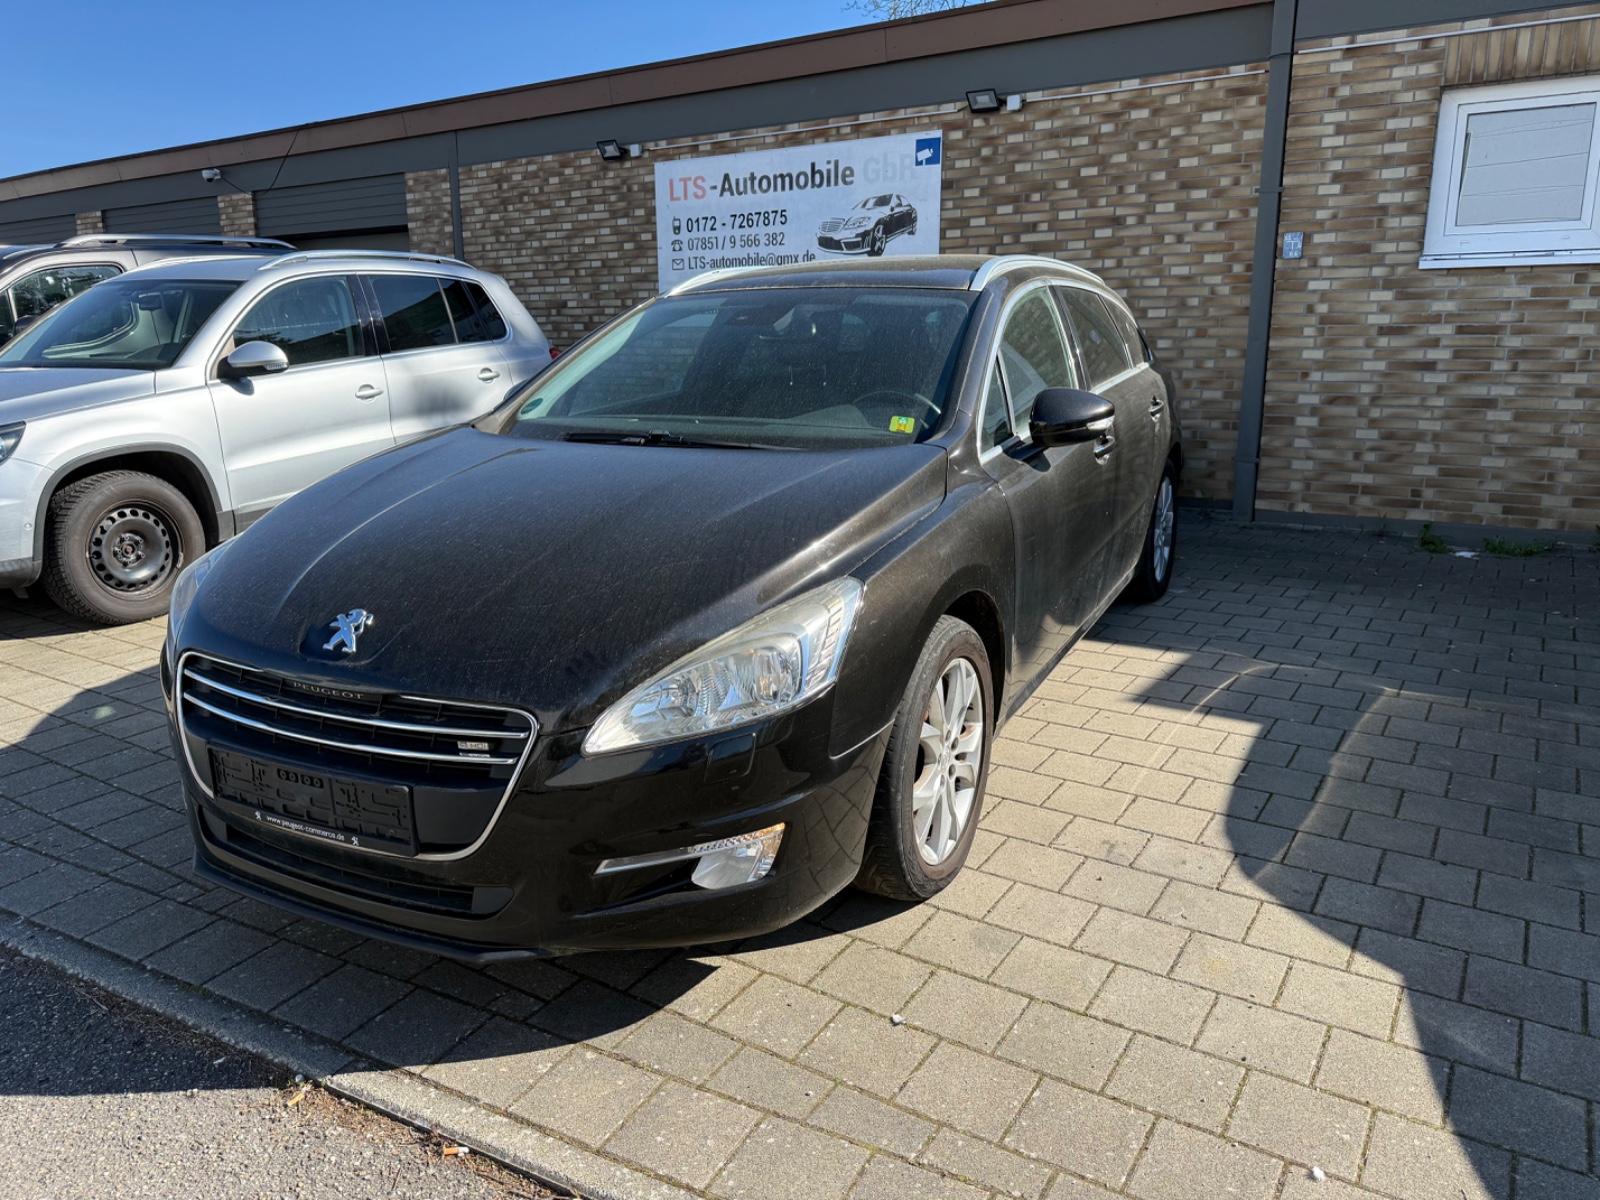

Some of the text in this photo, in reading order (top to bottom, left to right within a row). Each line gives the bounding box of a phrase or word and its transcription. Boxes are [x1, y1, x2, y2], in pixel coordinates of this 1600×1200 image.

[686, 216, 717, 232] 0172
[730, 209, 788, 229] 7267875
[729, 234, 736, 248] 9
[740, 233, 760, 248] 566
[764, 232, 785, 247] 382
[688, 250, 816, 270] LTS-automobile@gmxde
[293, 682, 364, 699] PEUGEOT
